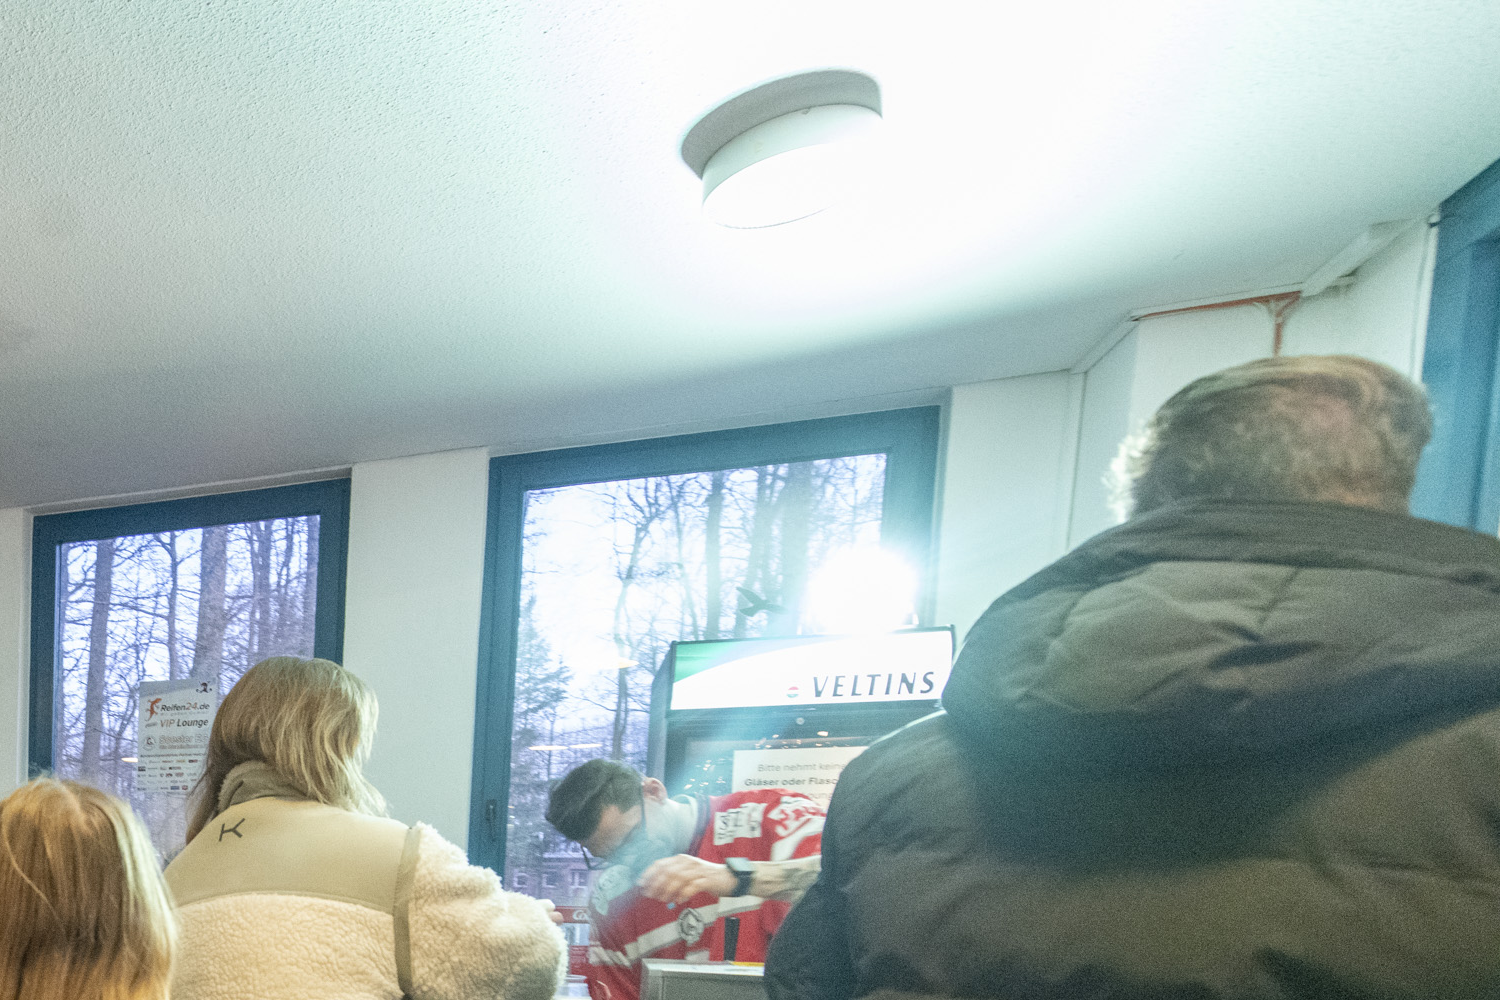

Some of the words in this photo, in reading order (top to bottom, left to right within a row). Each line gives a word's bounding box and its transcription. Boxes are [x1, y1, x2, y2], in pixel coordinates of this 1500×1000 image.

[813, 671, 934, 698] VELTINS
[160, 702, 210, 712] Reifen24.de
[160, 719, 175, 728] VIP
[177, 719, 209, 728] Lounge
[783, 763, 816, 771] nehmt
[781, 777, 806, 786] oder
